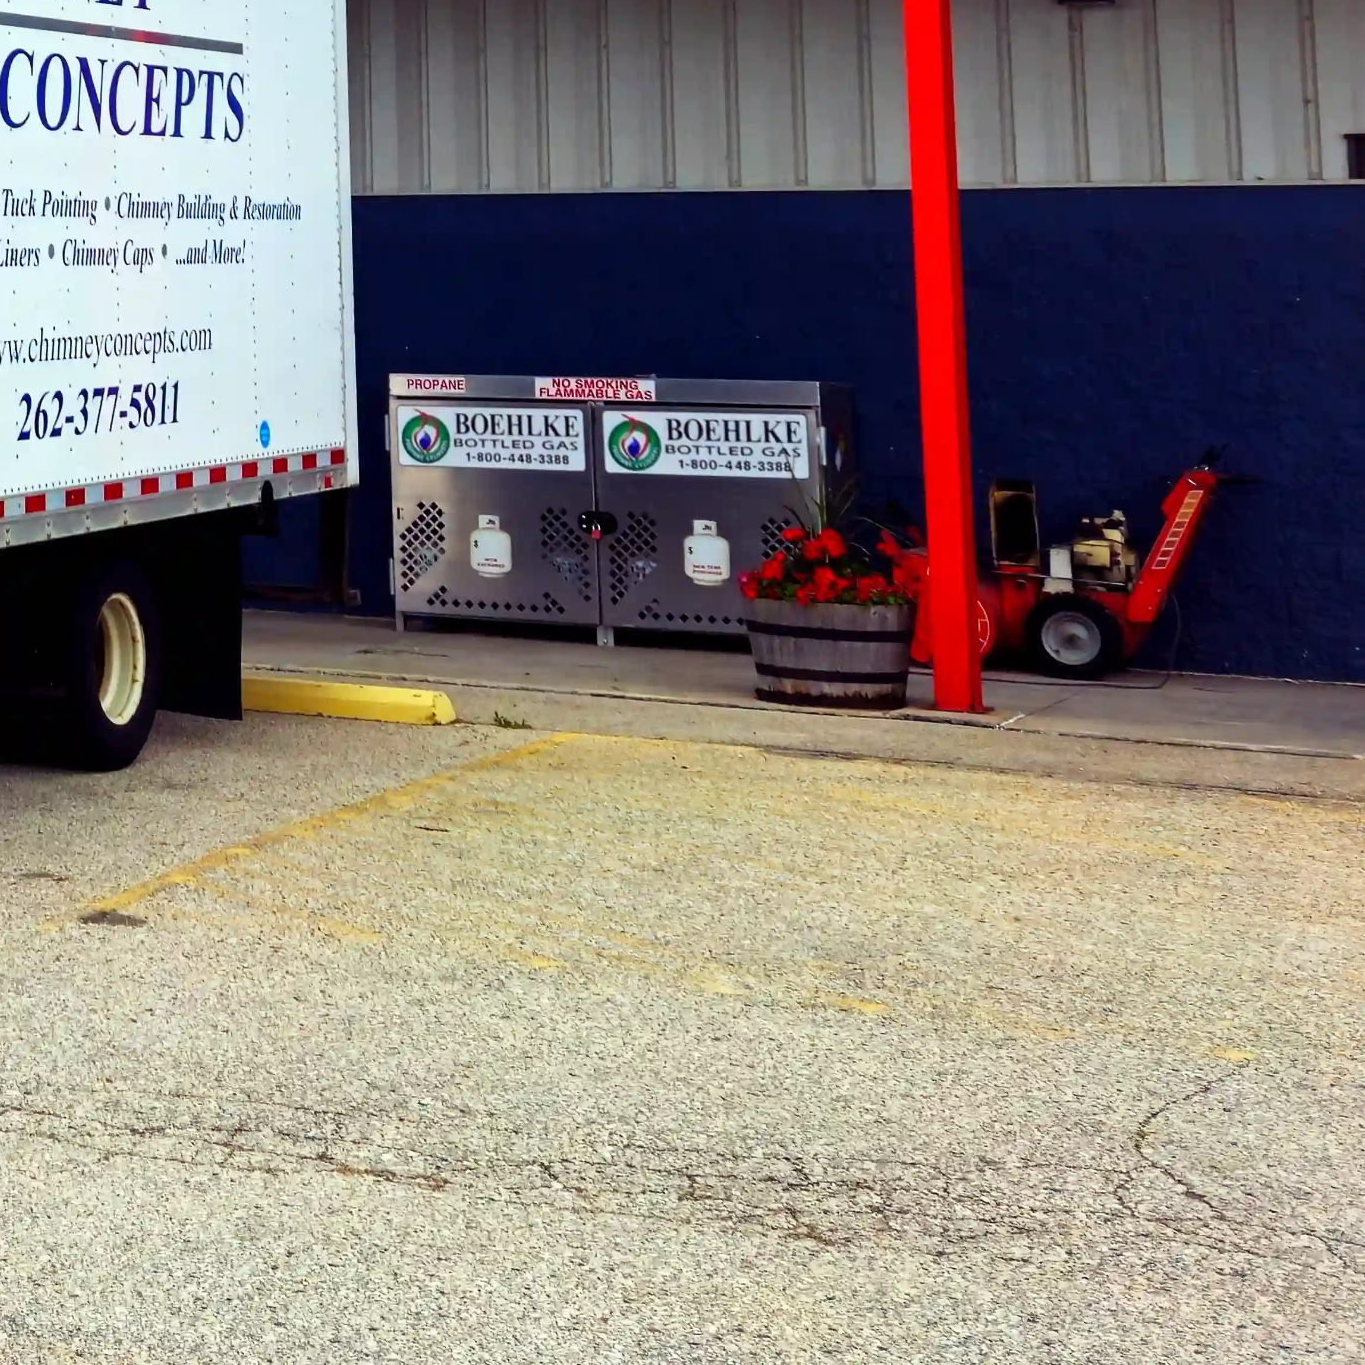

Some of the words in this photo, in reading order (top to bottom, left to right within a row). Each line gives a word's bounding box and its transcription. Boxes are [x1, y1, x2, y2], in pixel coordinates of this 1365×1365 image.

[2, 188, 36, 217] Tuck
[41, 189, 98, 226] Pointing
[118, 192, 173, 226] Chimney
[177, 194, 225, 226] Building
[229, 195, 239, 220] &
[243, 196, 302, 221] Restoration
[62, 239, 119, 274] Chimney
[123, 239, 155, 273] Caps
[211, 239, 246, 265] More!
[406, 378, 464, 390] PROPANE
[552, 378, 571, 389] NO
[575, 378, 639, 391] SMOKING
[539, 387, 621, 400] FLAMMABLE
[624, 389, 653, 401] GAS
[16, 380, 180, 441] 262-377-5811
[455, 413, 580, 438] BOEHLKE
[665, 418, 802, 444] BOEHLKE
[453, 438, 535, 450] BOTTLED
[542, 440, 579, 451] GAS
[665, 445, 754, 457] BOTTLED
[762, 447, 802, 458] GAS
[465, 452, 570, 465] 1-800-448-3388
[679, 459, 792, 473] 1-800-448-3388
